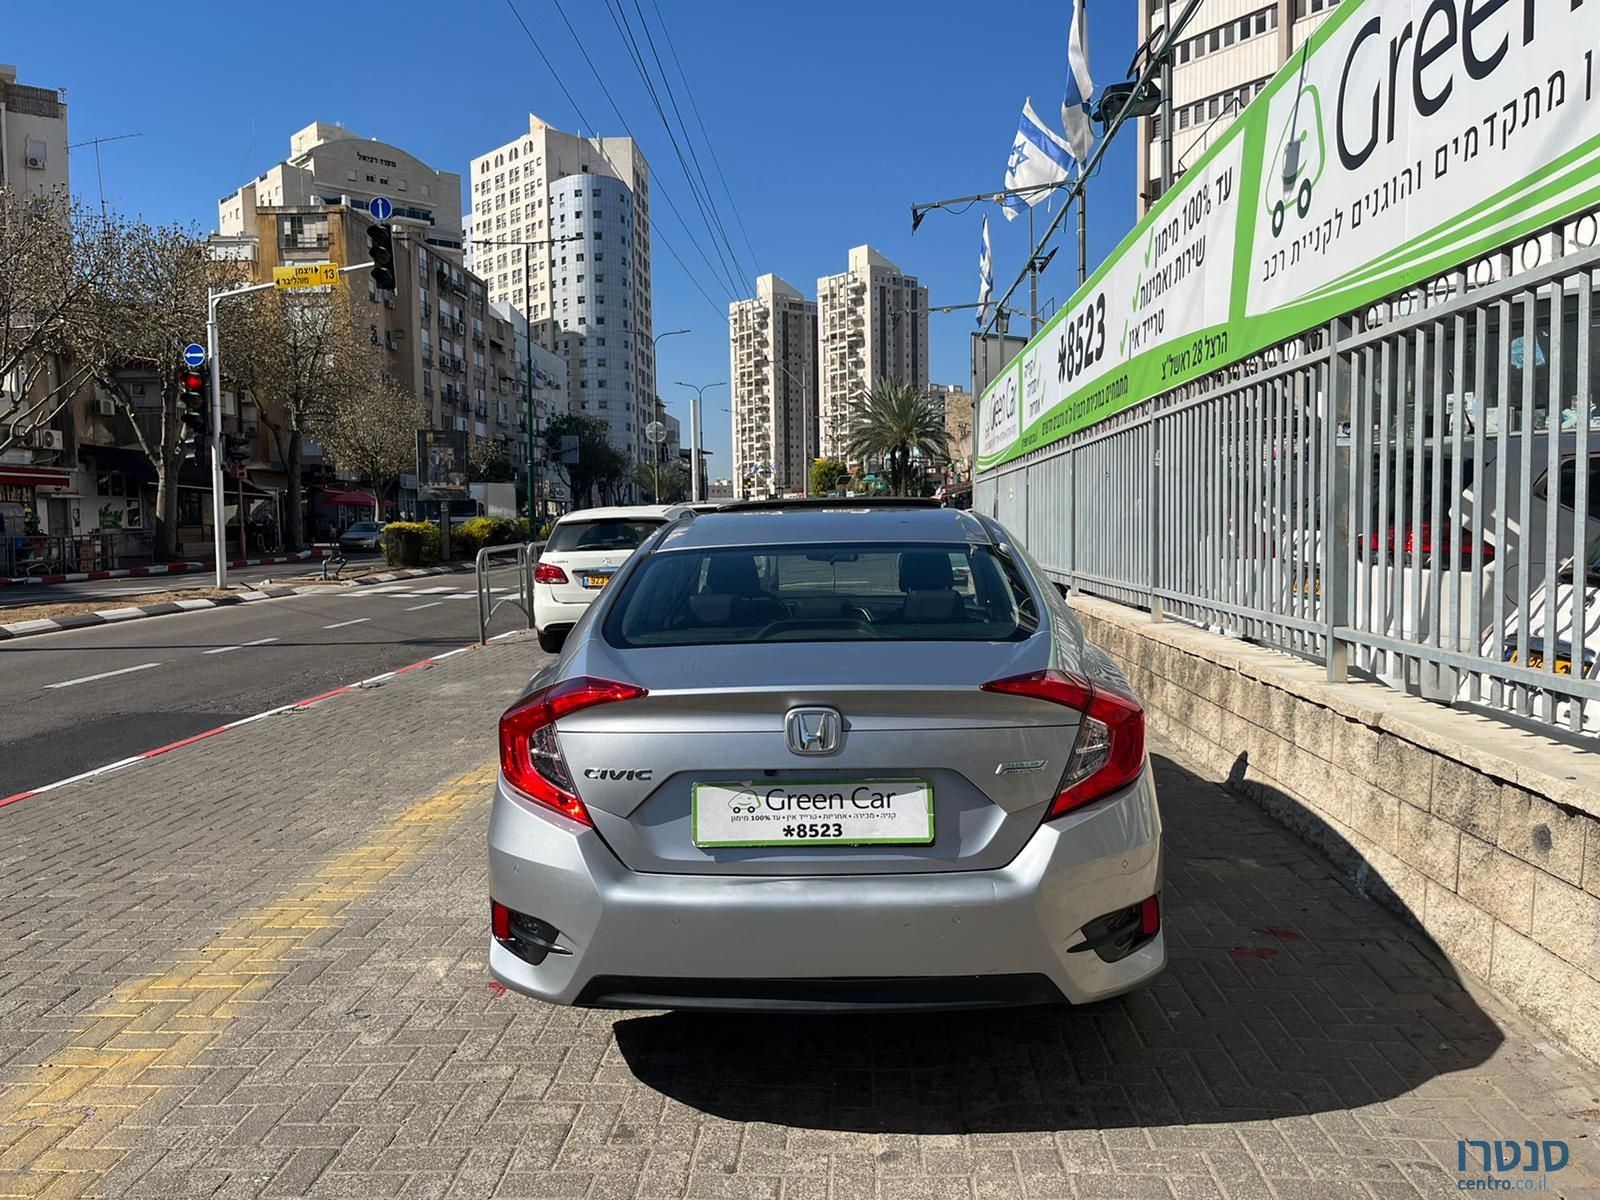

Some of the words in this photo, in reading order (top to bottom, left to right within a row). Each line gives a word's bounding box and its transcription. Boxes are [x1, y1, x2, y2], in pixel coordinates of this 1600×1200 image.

[1435, 70, 1565, 179] מתקדמים
[1215, 166, 1233, 206] עד
[1351, 160, 1422, 230] והוגנים
[1182, 183, 1212, 236] 100%
[1154, 217, 1179, 269] מימון
[1290, 208, 1344, 266] לקניית
[323, 268, 335, 280] 13
[1174, 234, 1206, 285] שירות
[1262, 250, 1285, 282] רכב
[1139, 262, 1172, 312] ואמינות
[1128, 324, 1141, 358] אין
[1141, 308, 1165, 344] טרייד
[1192, 338, 1203, 368] 28
[1204, 331, 1228, 361] הרצל
[583, 768, 653, 781] CIVIC
[765, 788, 844, 812] Green
[851, 786, 897, 810] Car
[730, 815, 749, 823] מימון
[751, 814, 771, 822] 100%
[773, 814, 781, 822] עד
[786, 814, 797, 822] אין
